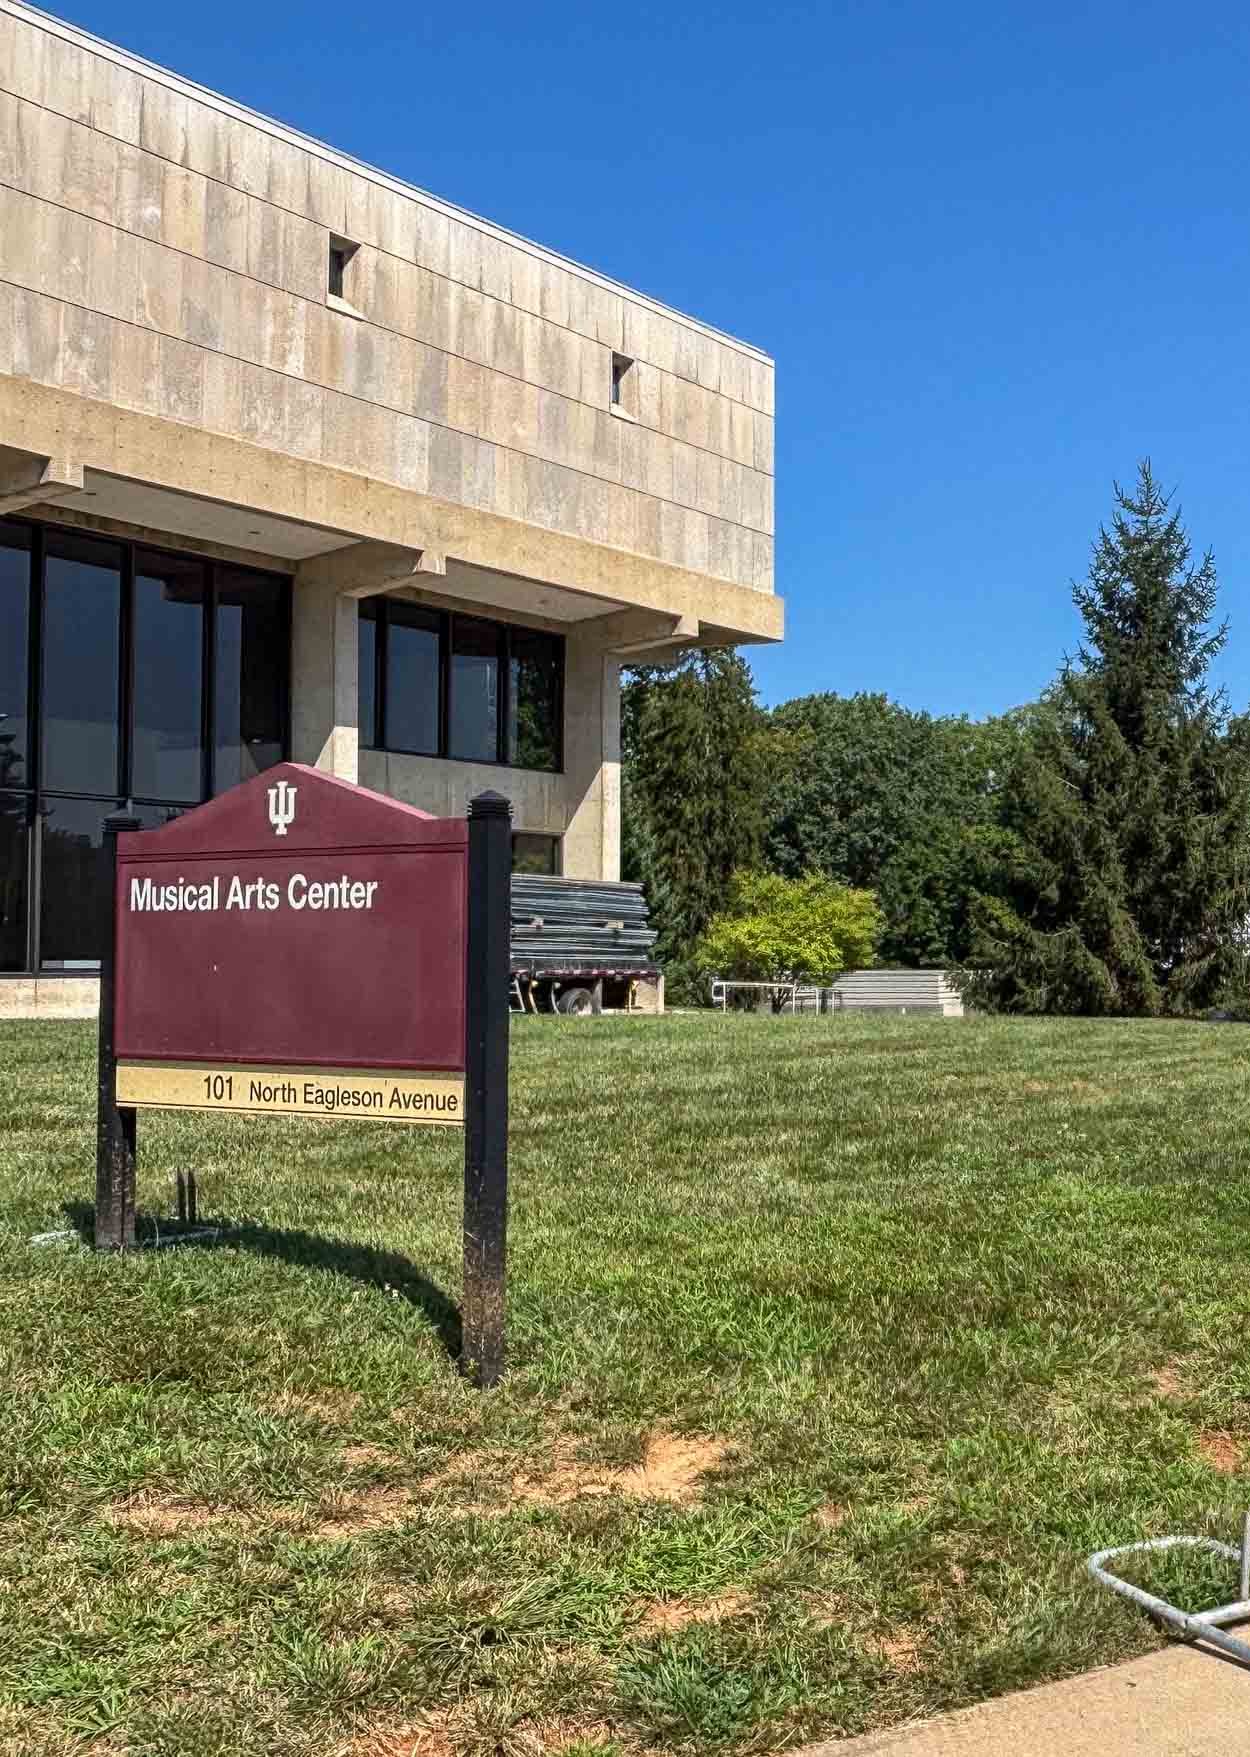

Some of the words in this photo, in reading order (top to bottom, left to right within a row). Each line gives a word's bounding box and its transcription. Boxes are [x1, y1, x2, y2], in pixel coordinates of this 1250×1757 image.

[130, 877, 219, 912] Musical
[226, 876, 280, 910] Arts
[287, 873, 378, 909] Center
[203, 1075, 234, 1102] 101
[249, 1080, 297, 1105] North
[303, 1083, 383, 1112] Eagleson
[388, 1087, 458, 1113] Avenue
